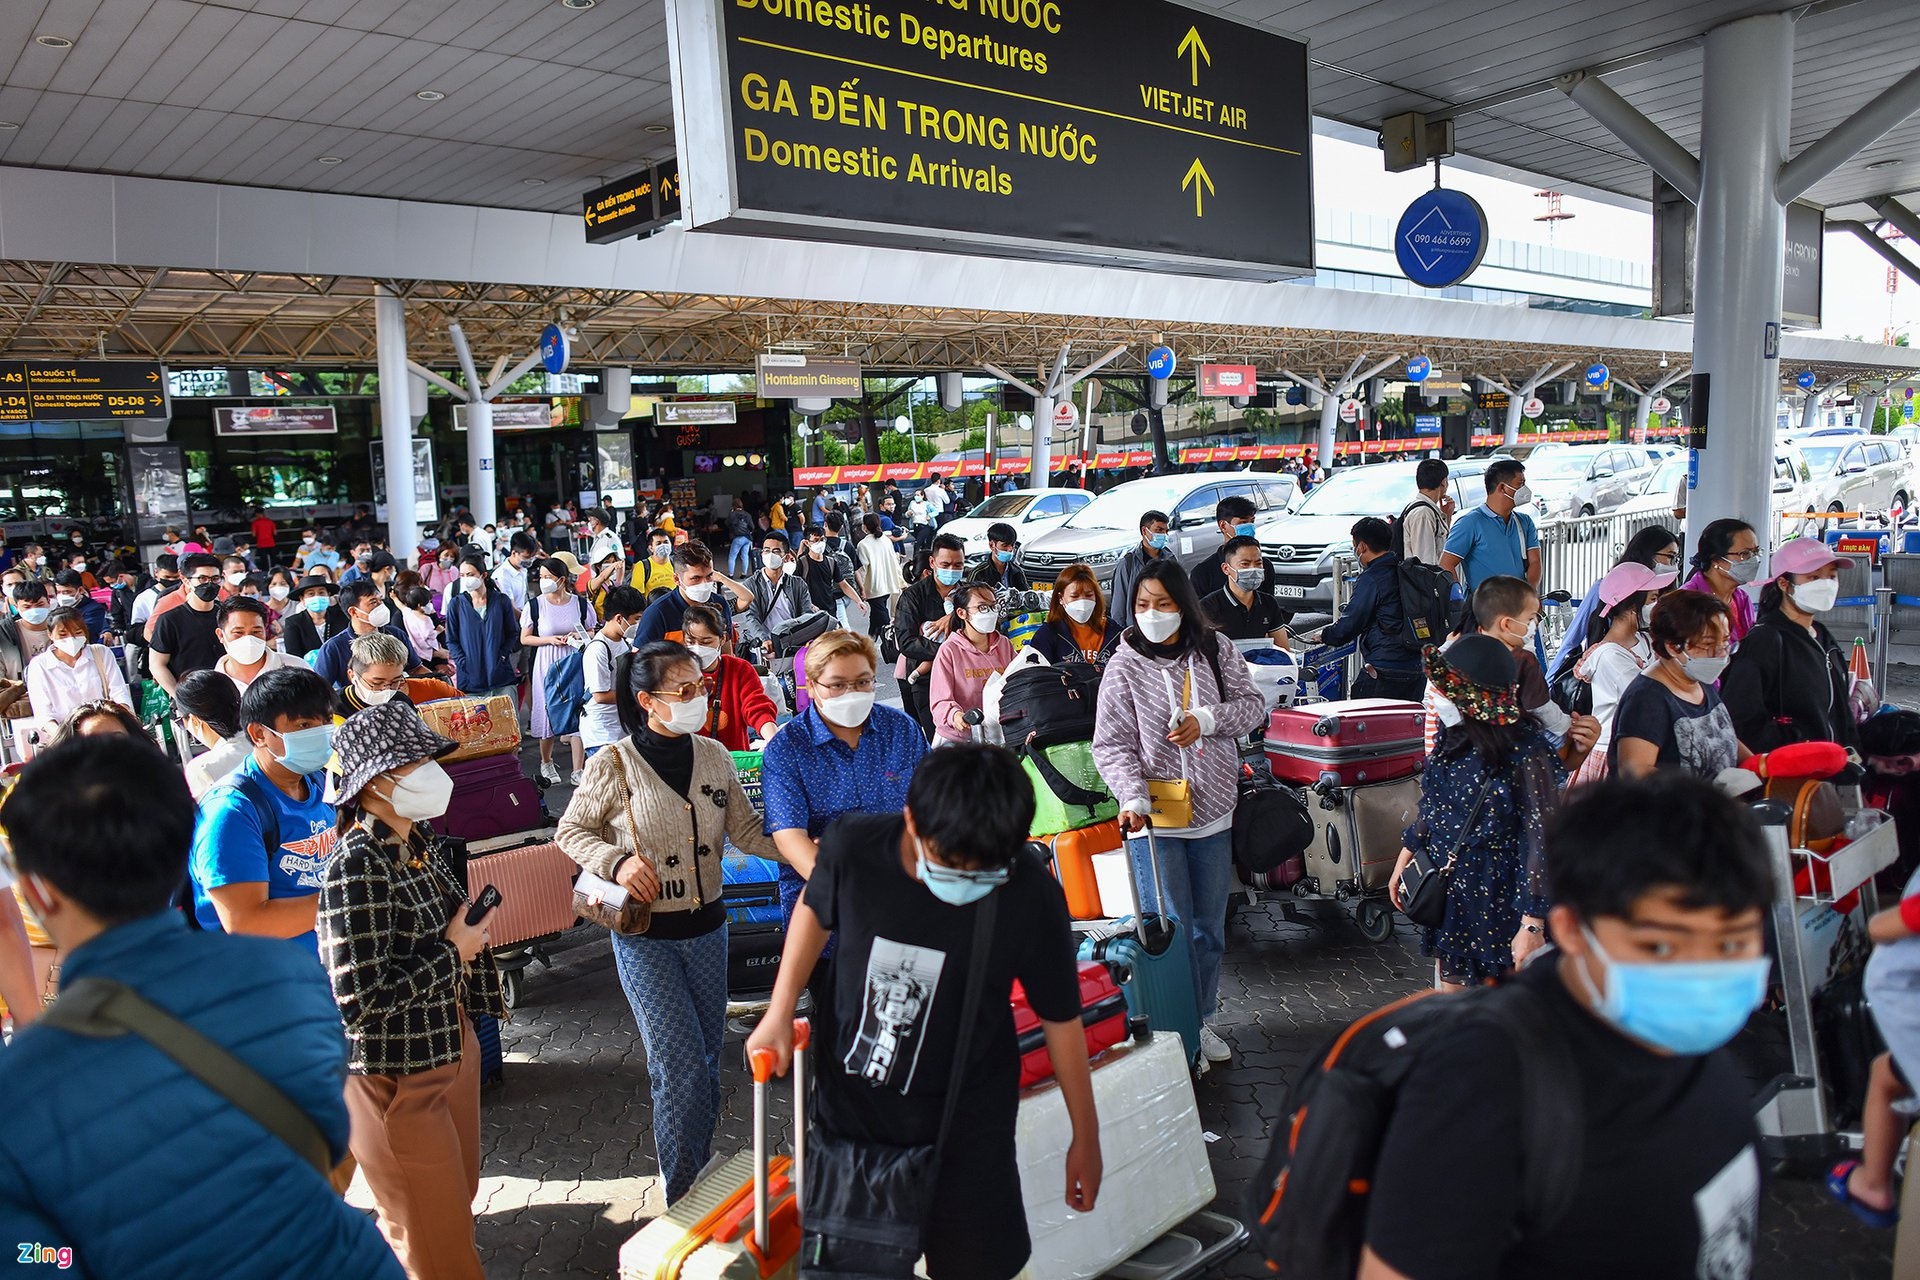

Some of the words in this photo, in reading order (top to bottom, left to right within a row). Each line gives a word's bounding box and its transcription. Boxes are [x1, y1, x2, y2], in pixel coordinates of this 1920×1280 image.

[736, 0, 890, 39] omestic
[899, 13, 1048, 75] Departures
[1139, 84, 1215, 121] VIETJET
[1219, 102, 1247, 130] AIR
[741, 73, 799, 117] GA
[810, 78, 886, 131] ĐẾN
[897, 101, 1009, 151] TRONG
[1019, 123, 1097, 165] NƯỚC
[744, 128, 897, 181] Domestic
[907, 153, 1013, 196] Arrivals
[1414, 234, 1430, 243] 090
[1431, 235, 1447, 245] 464
[1449, 236, 1471, 246] 6699
[1148, 359, 1164, 370] VIB
[1408, 366, 1421, 374] VIB
[43, 369, 65, 377] QUỐC
[764, 373, 818, 386] Homtamin
[819, 374, 859, 388] Ginseng
[108, 396, 145, 406] D5-D8
[286, 856, 310, 869] HARD
